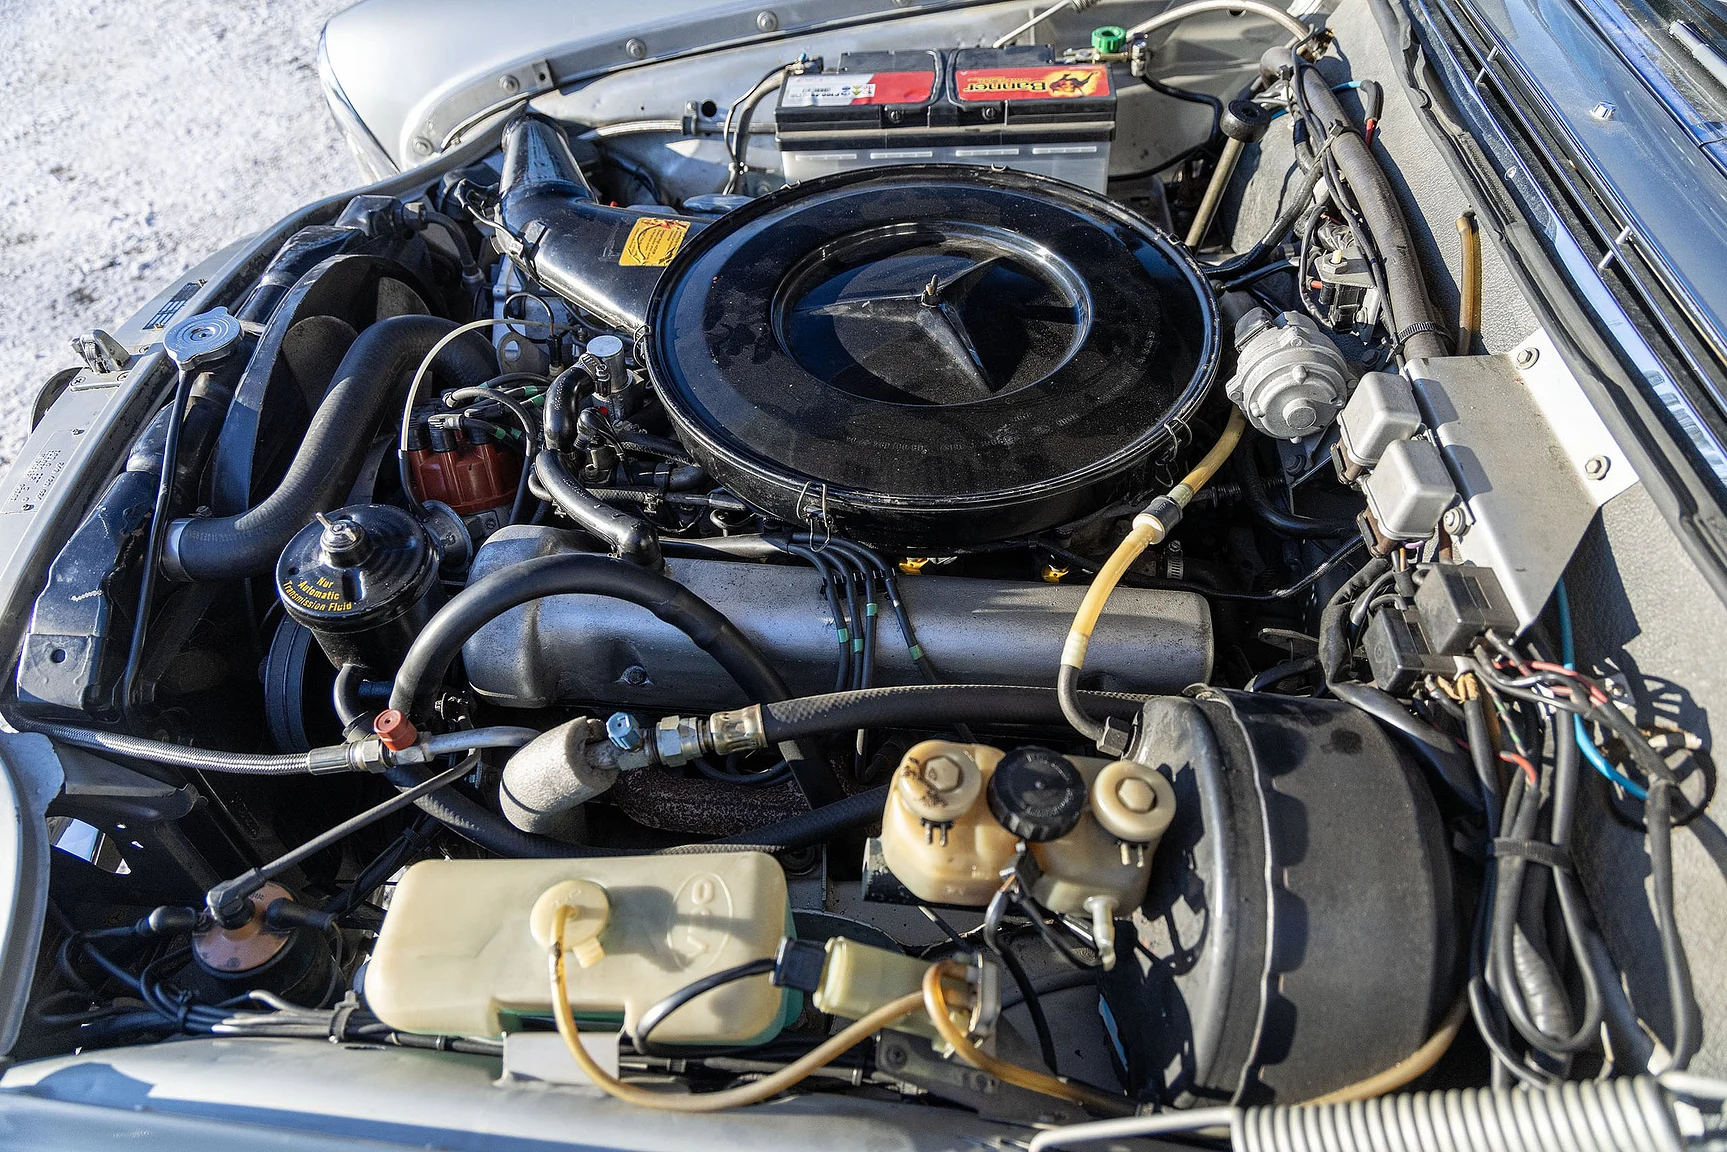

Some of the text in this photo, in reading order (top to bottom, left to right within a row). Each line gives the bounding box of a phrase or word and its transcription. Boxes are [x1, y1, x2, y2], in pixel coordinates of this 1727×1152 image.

[963, 81, 1047, 93] Banner
[297, 580, 340, 600] Automatic
[316, 577, 334, 588] Nur
[283, 580, 352, 611] Transmission Fluid
